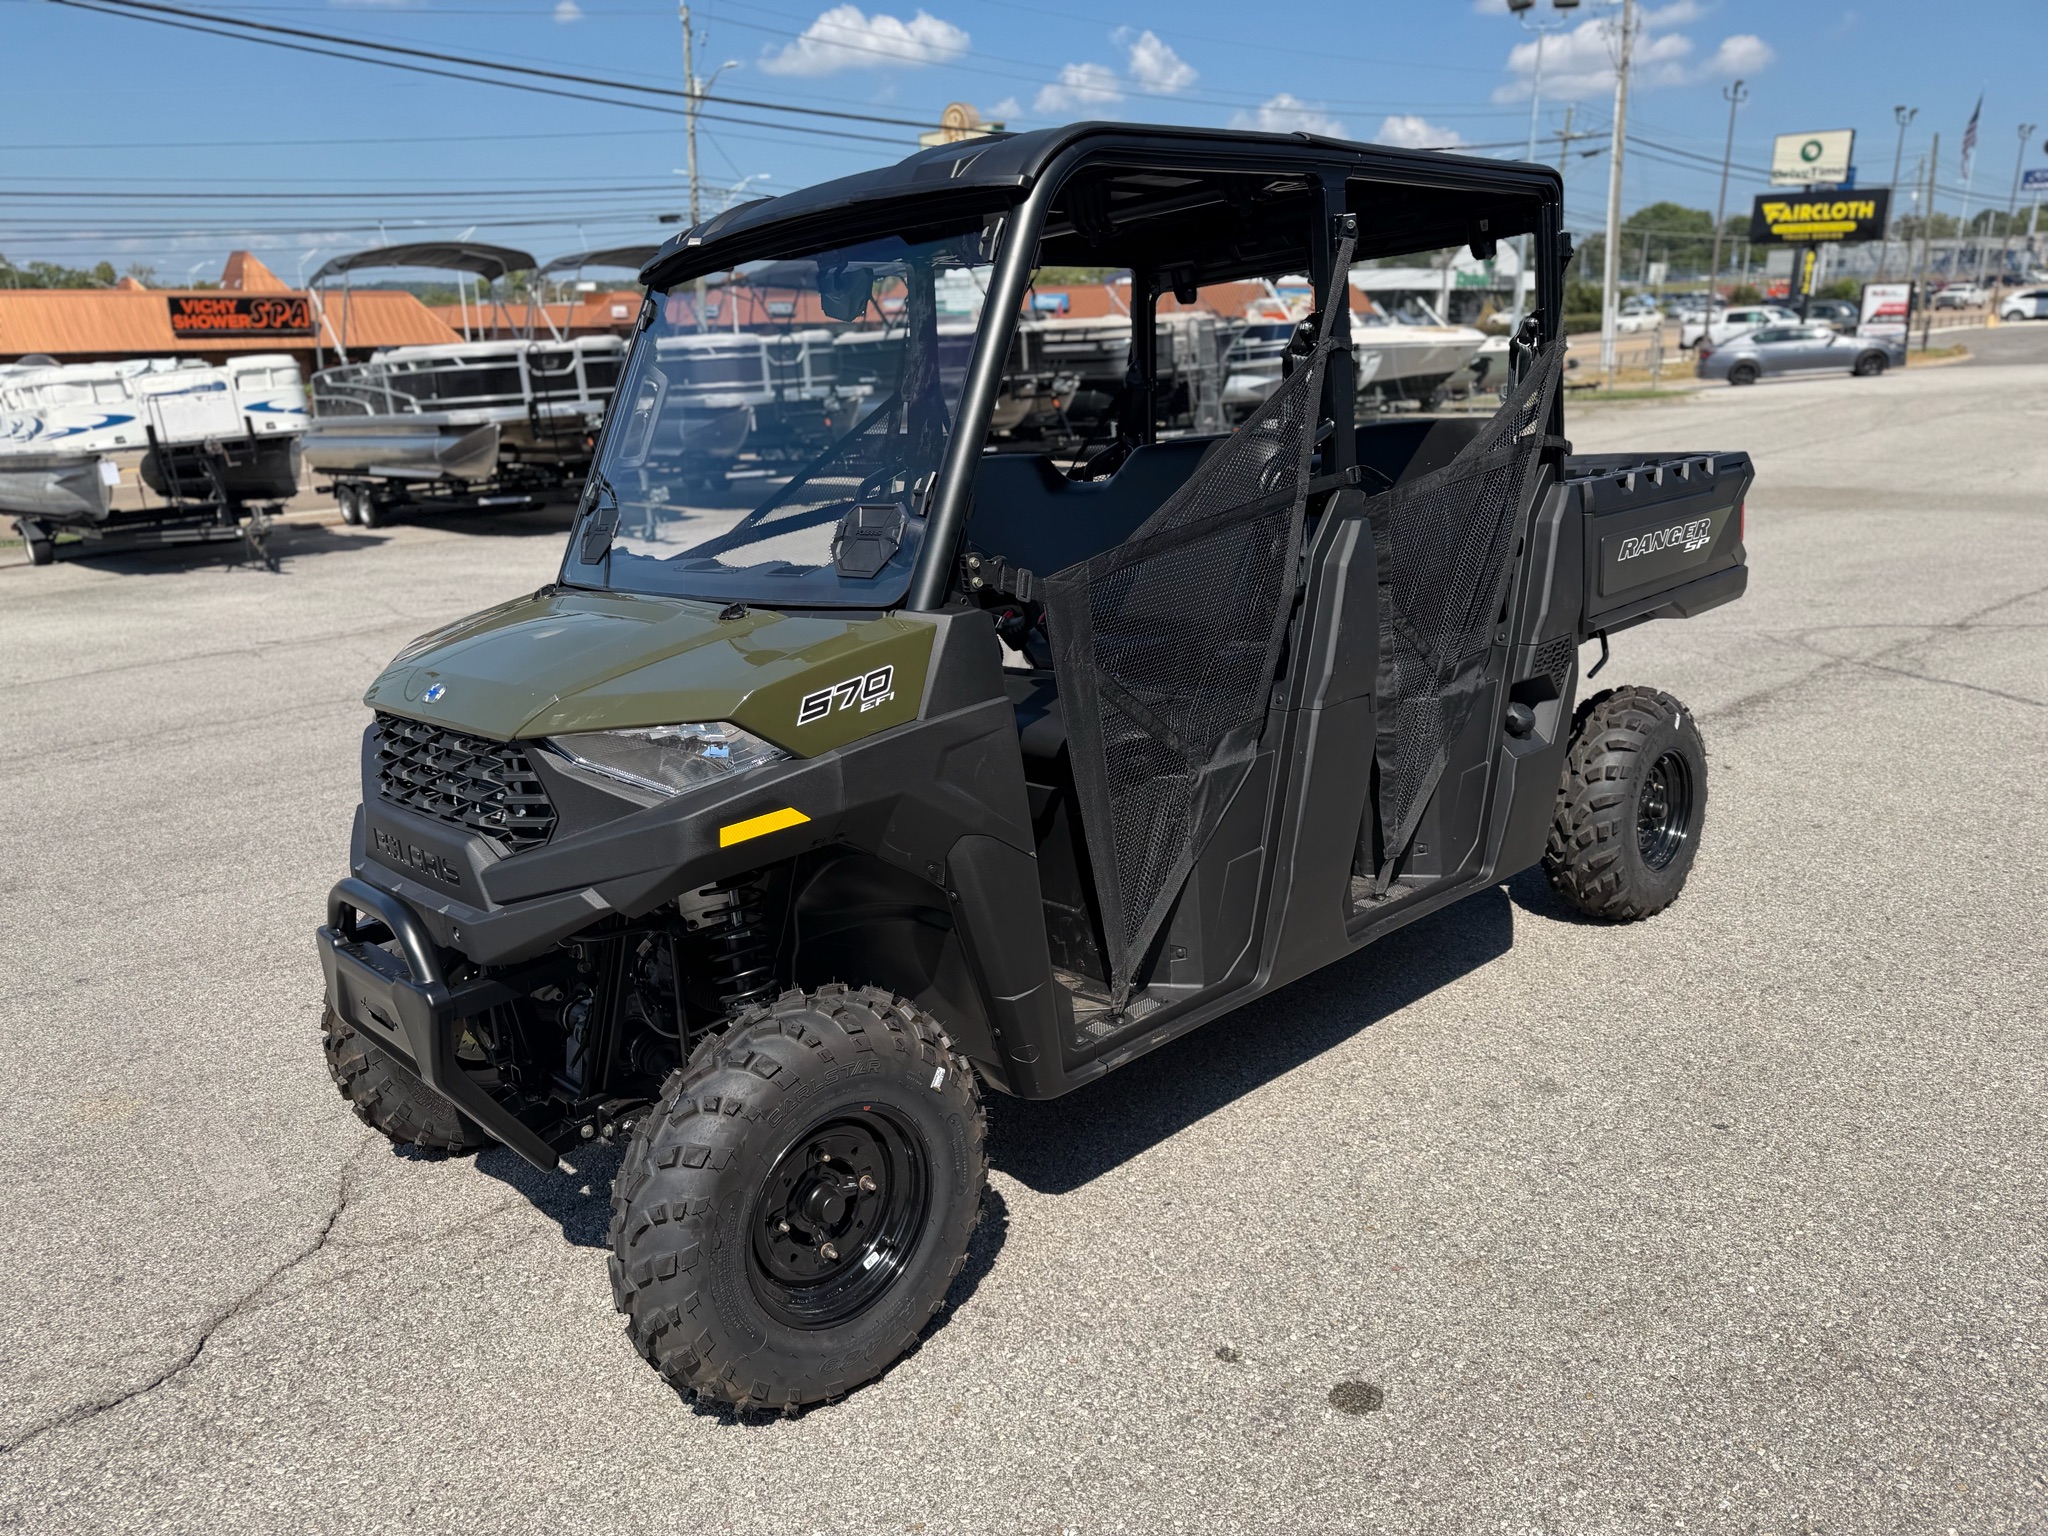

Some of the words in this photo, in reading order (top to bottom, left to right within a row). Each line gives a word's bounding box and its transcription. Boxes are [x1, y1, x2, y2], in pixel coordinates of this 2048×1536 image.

[1762, 200, 1876, 224] FAIRCLOTH
[180, 298, 237, 314] VICHY
[250, 298, 310, 330] SPA
[172, 313, 251, 331] SHOWER
[1617, 518, 1711, 562] RANGER
[1683, 536, 1711, 553] SP
[797, 664, 894, 727] 570
[860, 691, 895, 713] EFI
[373, 827, 461, 887] POLARIS
[767, 1058, 882, 1128] CARLSTAR
